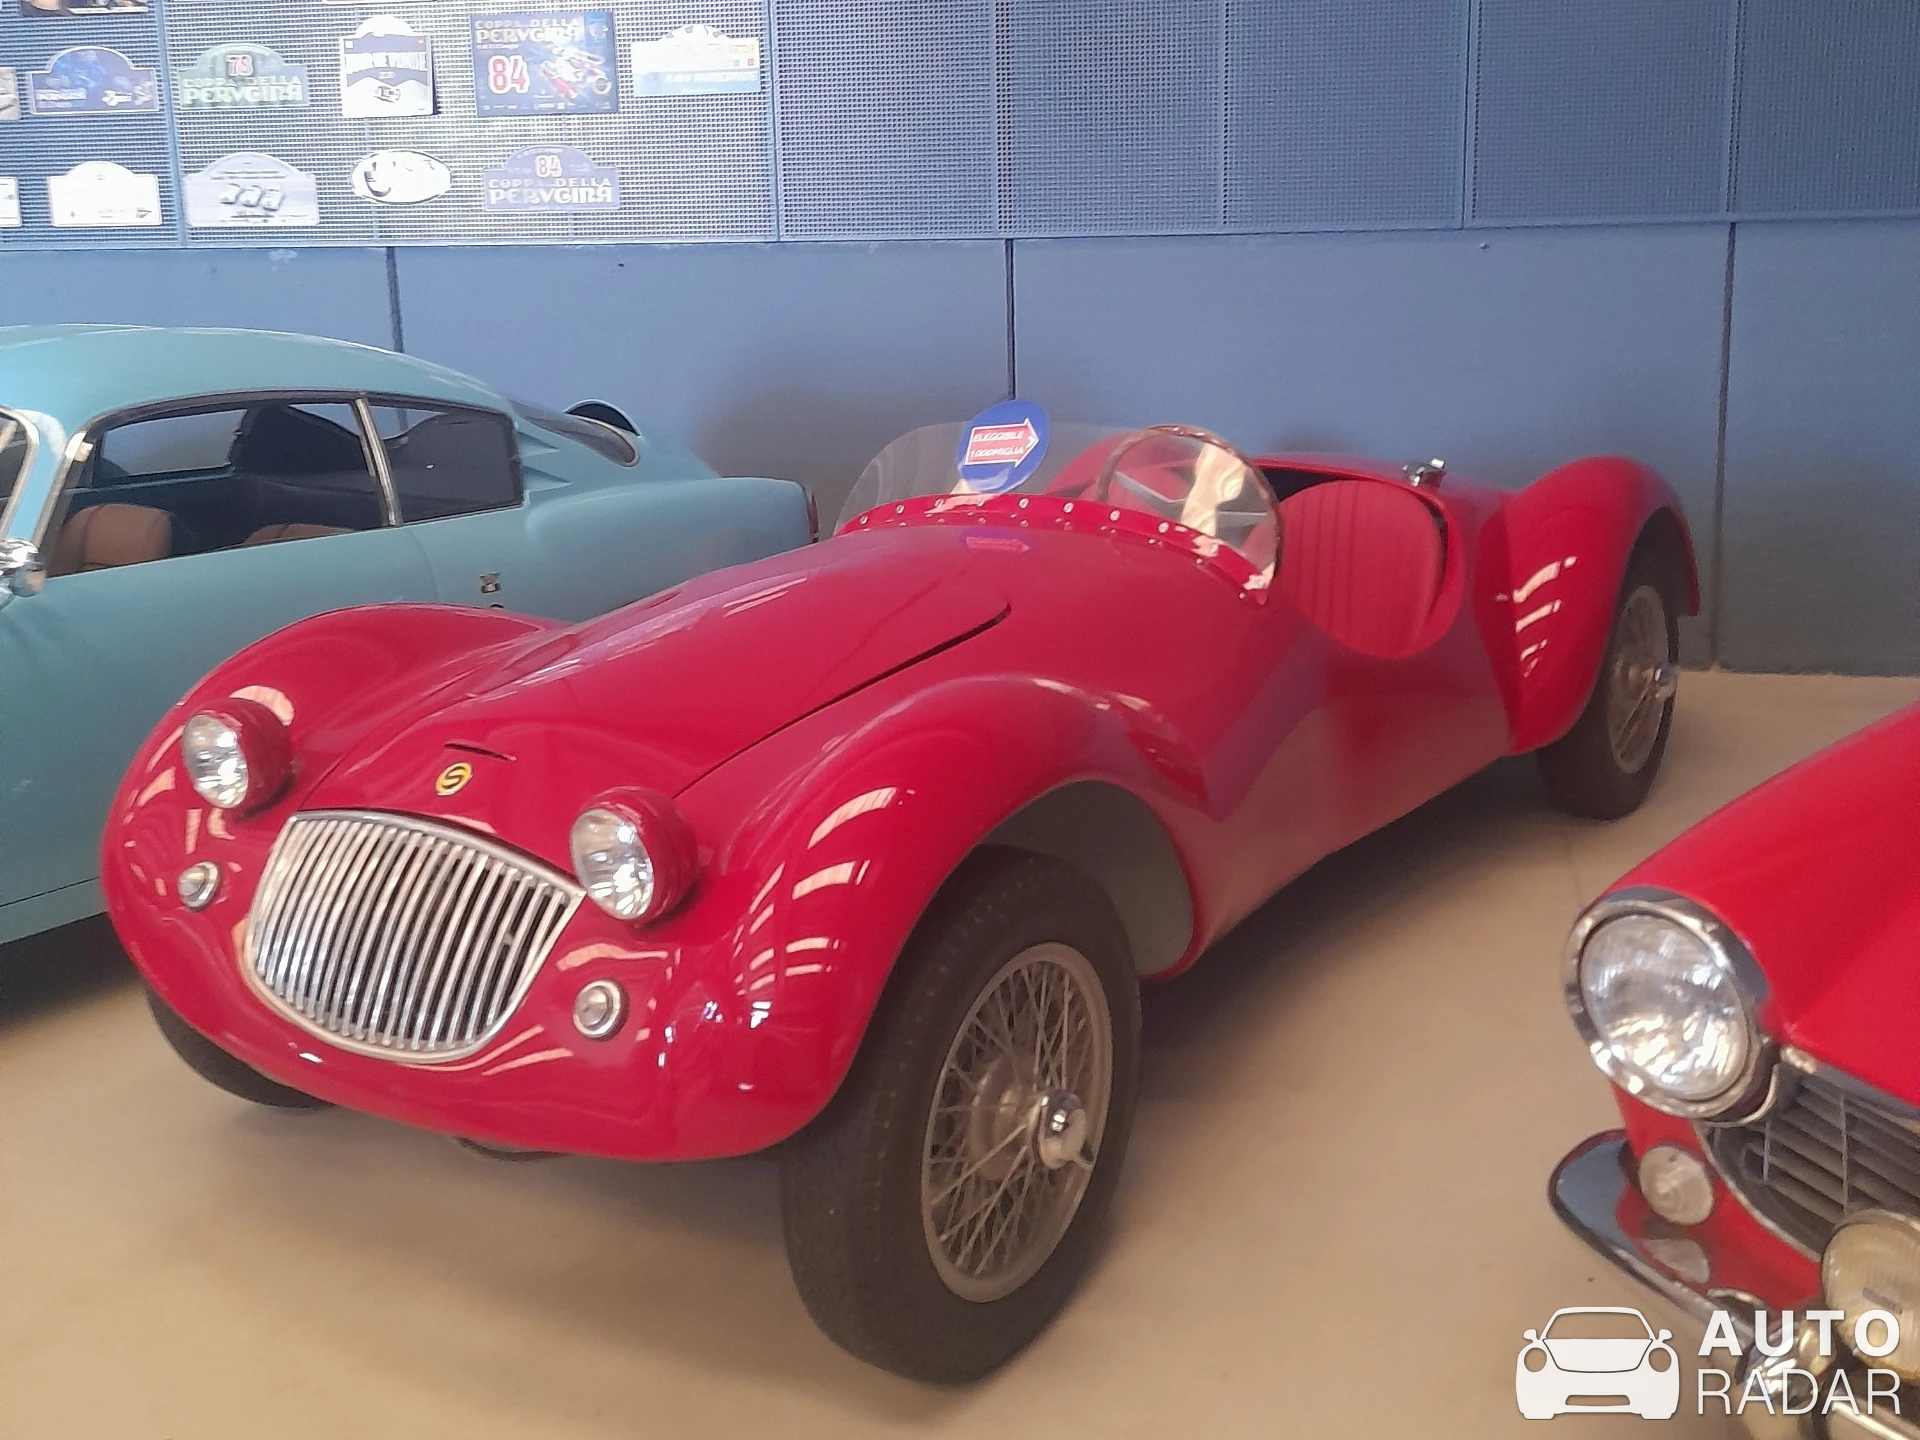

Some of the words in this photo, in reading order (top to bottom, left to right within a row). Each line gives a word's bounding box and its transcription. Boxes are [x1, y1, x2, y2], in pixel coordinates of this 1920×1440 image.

[530, 18, 579, 28] DELLA
[488, 55, 530, 94] 84
[535, 155, 562, 178] 84
[556, 177, 612, 187] DELLA
